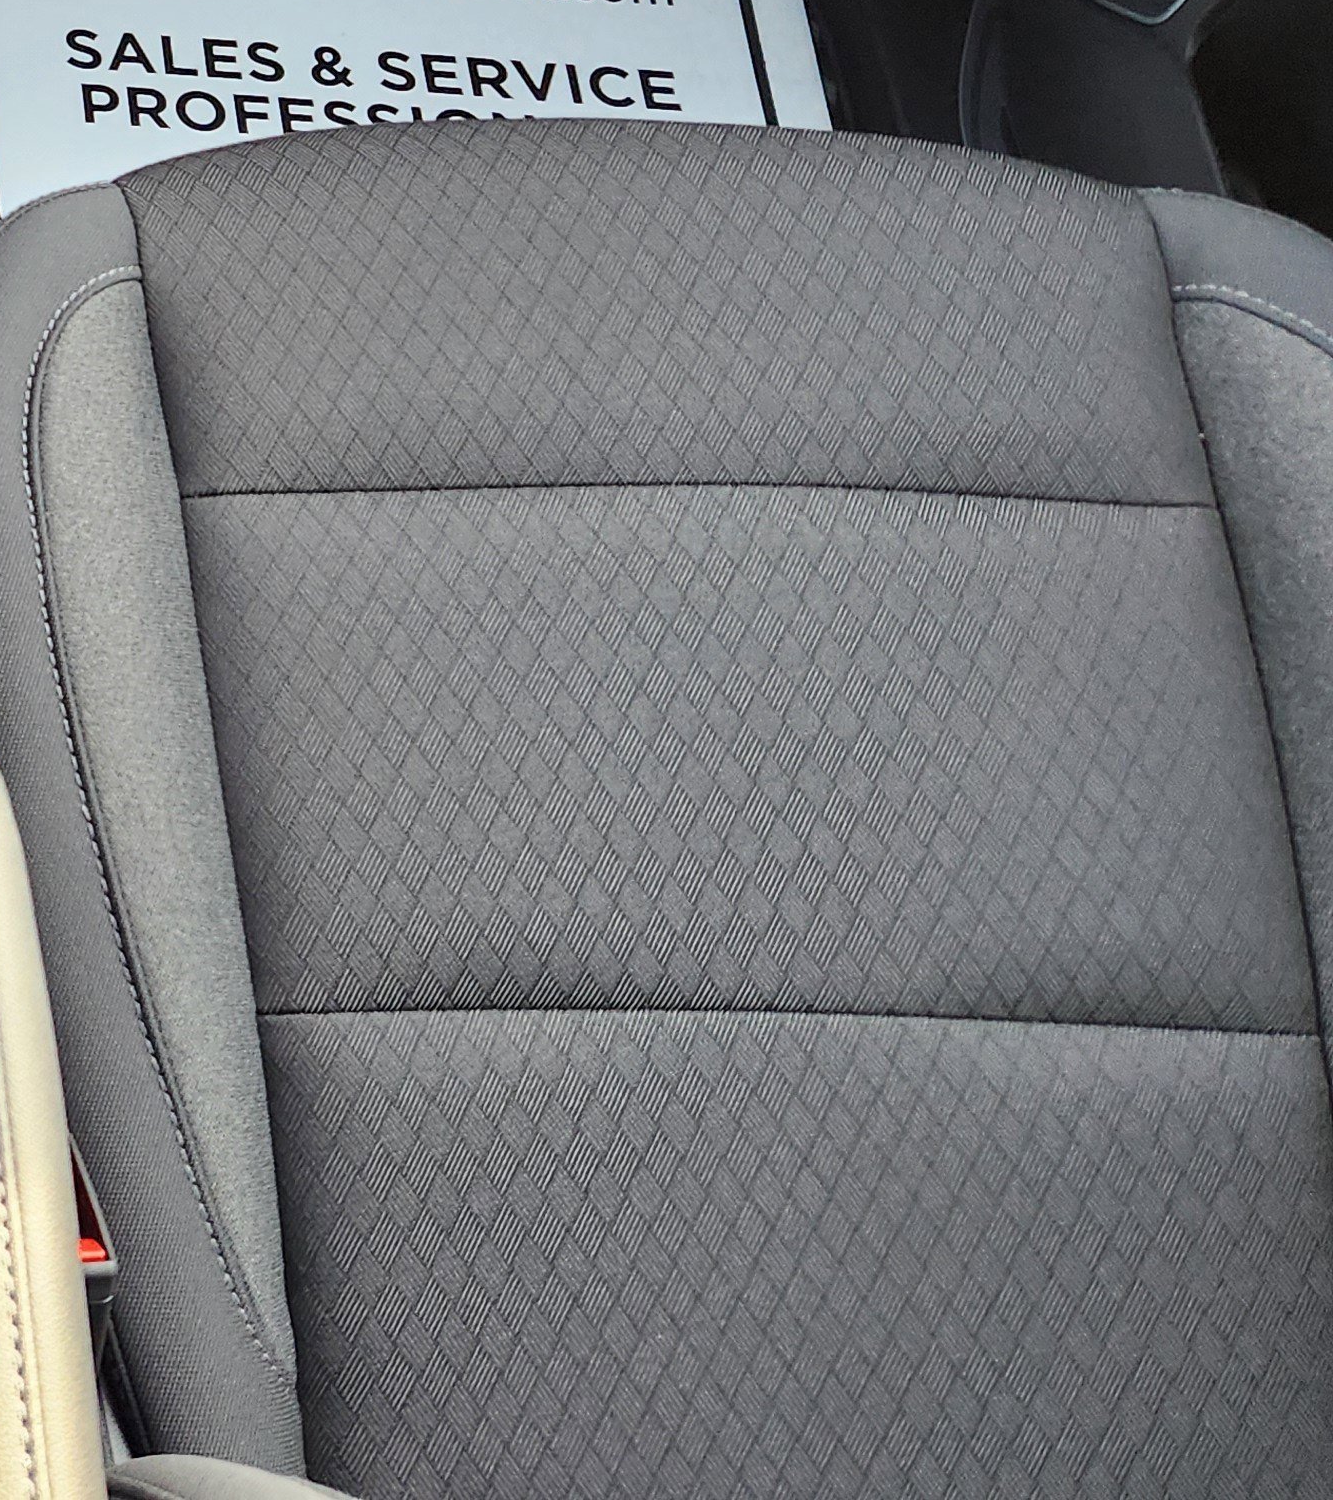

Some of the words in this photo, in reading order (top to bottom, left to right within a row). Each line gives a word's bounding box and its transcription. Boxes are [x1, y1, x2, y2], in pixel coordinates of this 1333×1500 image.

[65, 29, 285, 83] SALES
[311, 46, 352, 89] &
[379, 51, 683, 111] SERVICE
